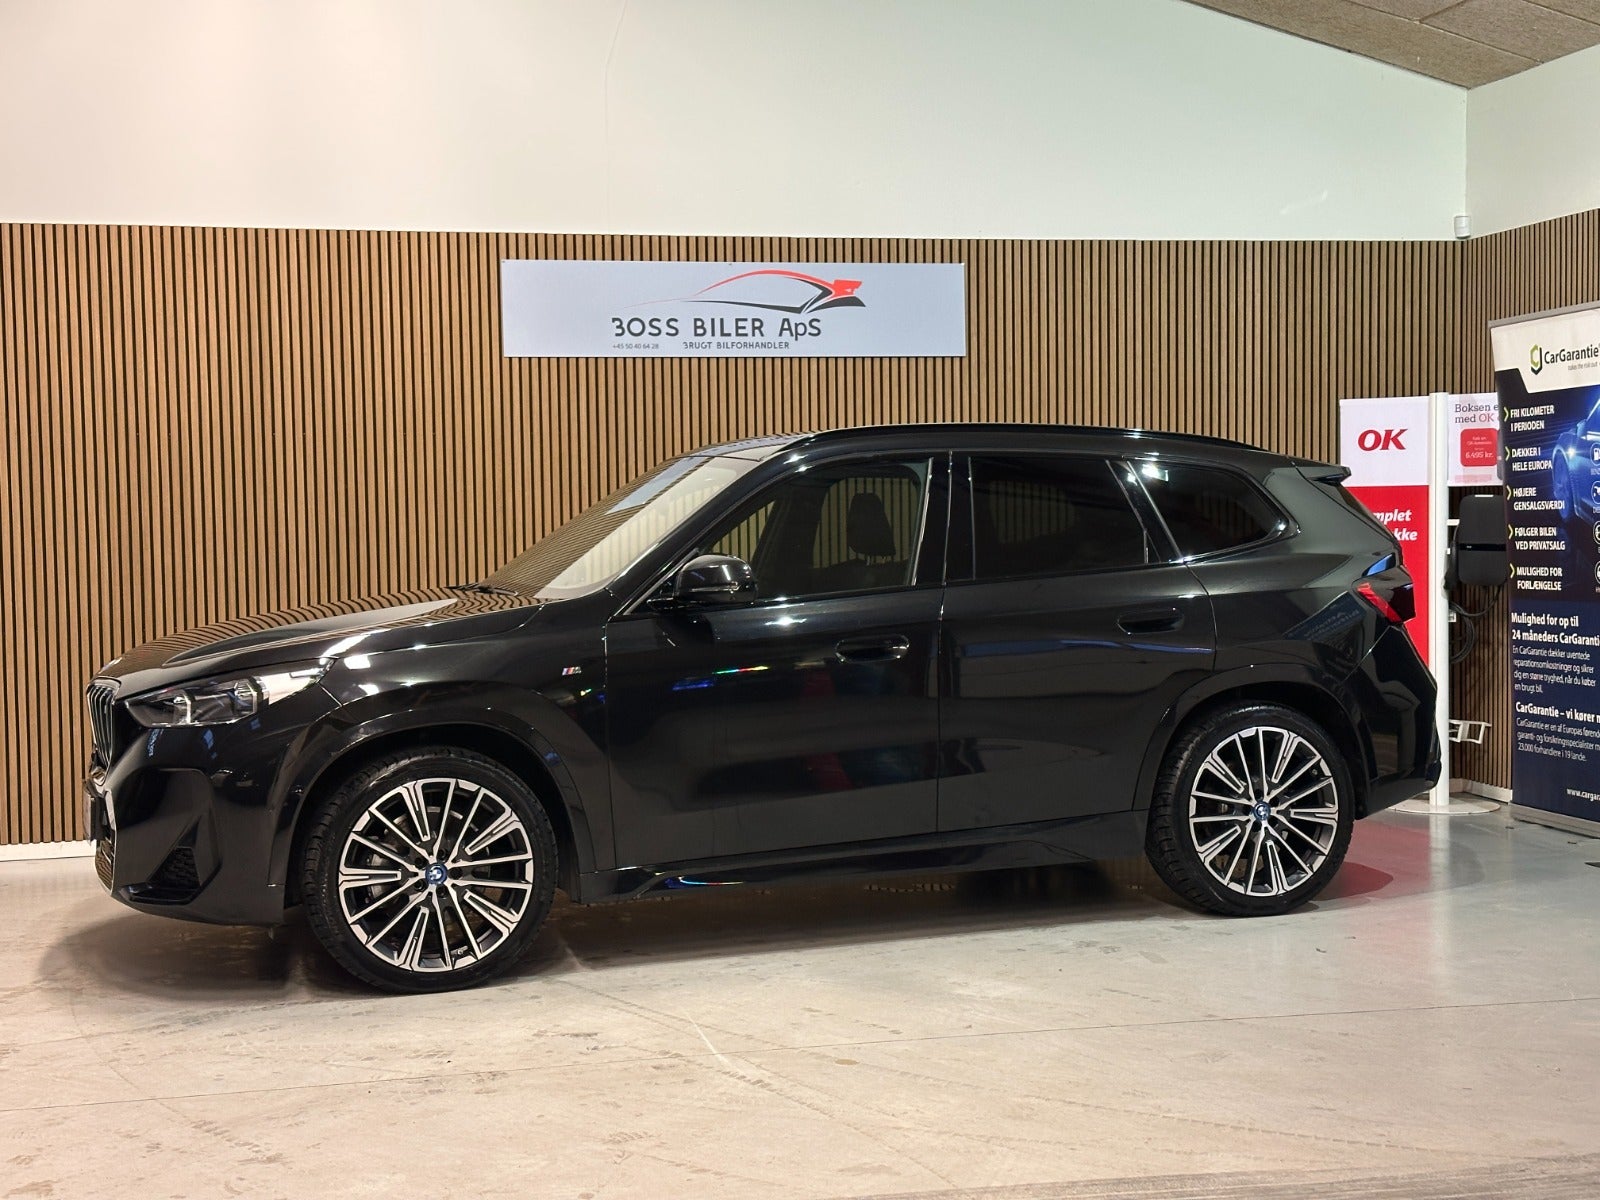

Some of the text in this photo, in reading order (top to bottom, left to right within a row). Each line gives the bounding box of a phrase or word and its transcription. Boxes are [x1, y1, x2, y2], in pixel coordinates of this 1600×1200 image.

[693, 317, 764, 337] BILER
[778, 317, 822, 341] ApS
[717, 342, 790, 350] BILFORHANDLER
[1454, 403, 1491, 413] Boksen
[1510, 405, 1555, 418] FRI KILOMETER
[1455, 413, 1494, 423] med OK
[1514, 420, 1545, 432] PERIODEN
[1358, 428, 1408, 452] OK
[1511, 447, 1537, 458] DÆKKER
[1512, 460, 1552, 471] HELE EUROPA
[1513, 487, 1537, 497] HØJERE
[1513, 500, 1565, 511] GENSALGSVÆRDI
[1372, 508, 1412, 525] mplet
[1394, 527, 1418, 541] kke
[1514, 527, 1557, 537] FØLGER BILEN
[1515, 541, 1566, 551] VED PRIVATSALG
[1516, 566, 1563, 577] MULIGHED FOR
[1517, 580, 1562, 591] FORLÆNGELSE
[1511, 612, 1579, 629] Mulighed for op til
[1512, 629, 1600, 647] 24 måneders CarGaranti
[1519, 645, 1548, 657] CarGarantie
[1573, 665, 1580, 674] og
[1513, 670, 1521, 680] dig
[1573, 675, 1581, 685] du
[1514, 683, 1521, 691] en
[1516, 701, 1559, 717] CarGarantie
[1565, 708, 1573, 720] vi
[1574, 708, 1595, 723] kører
[1516, 717, 1545, 730] CarGarantie
[1535, 734, 1543, 744] og
